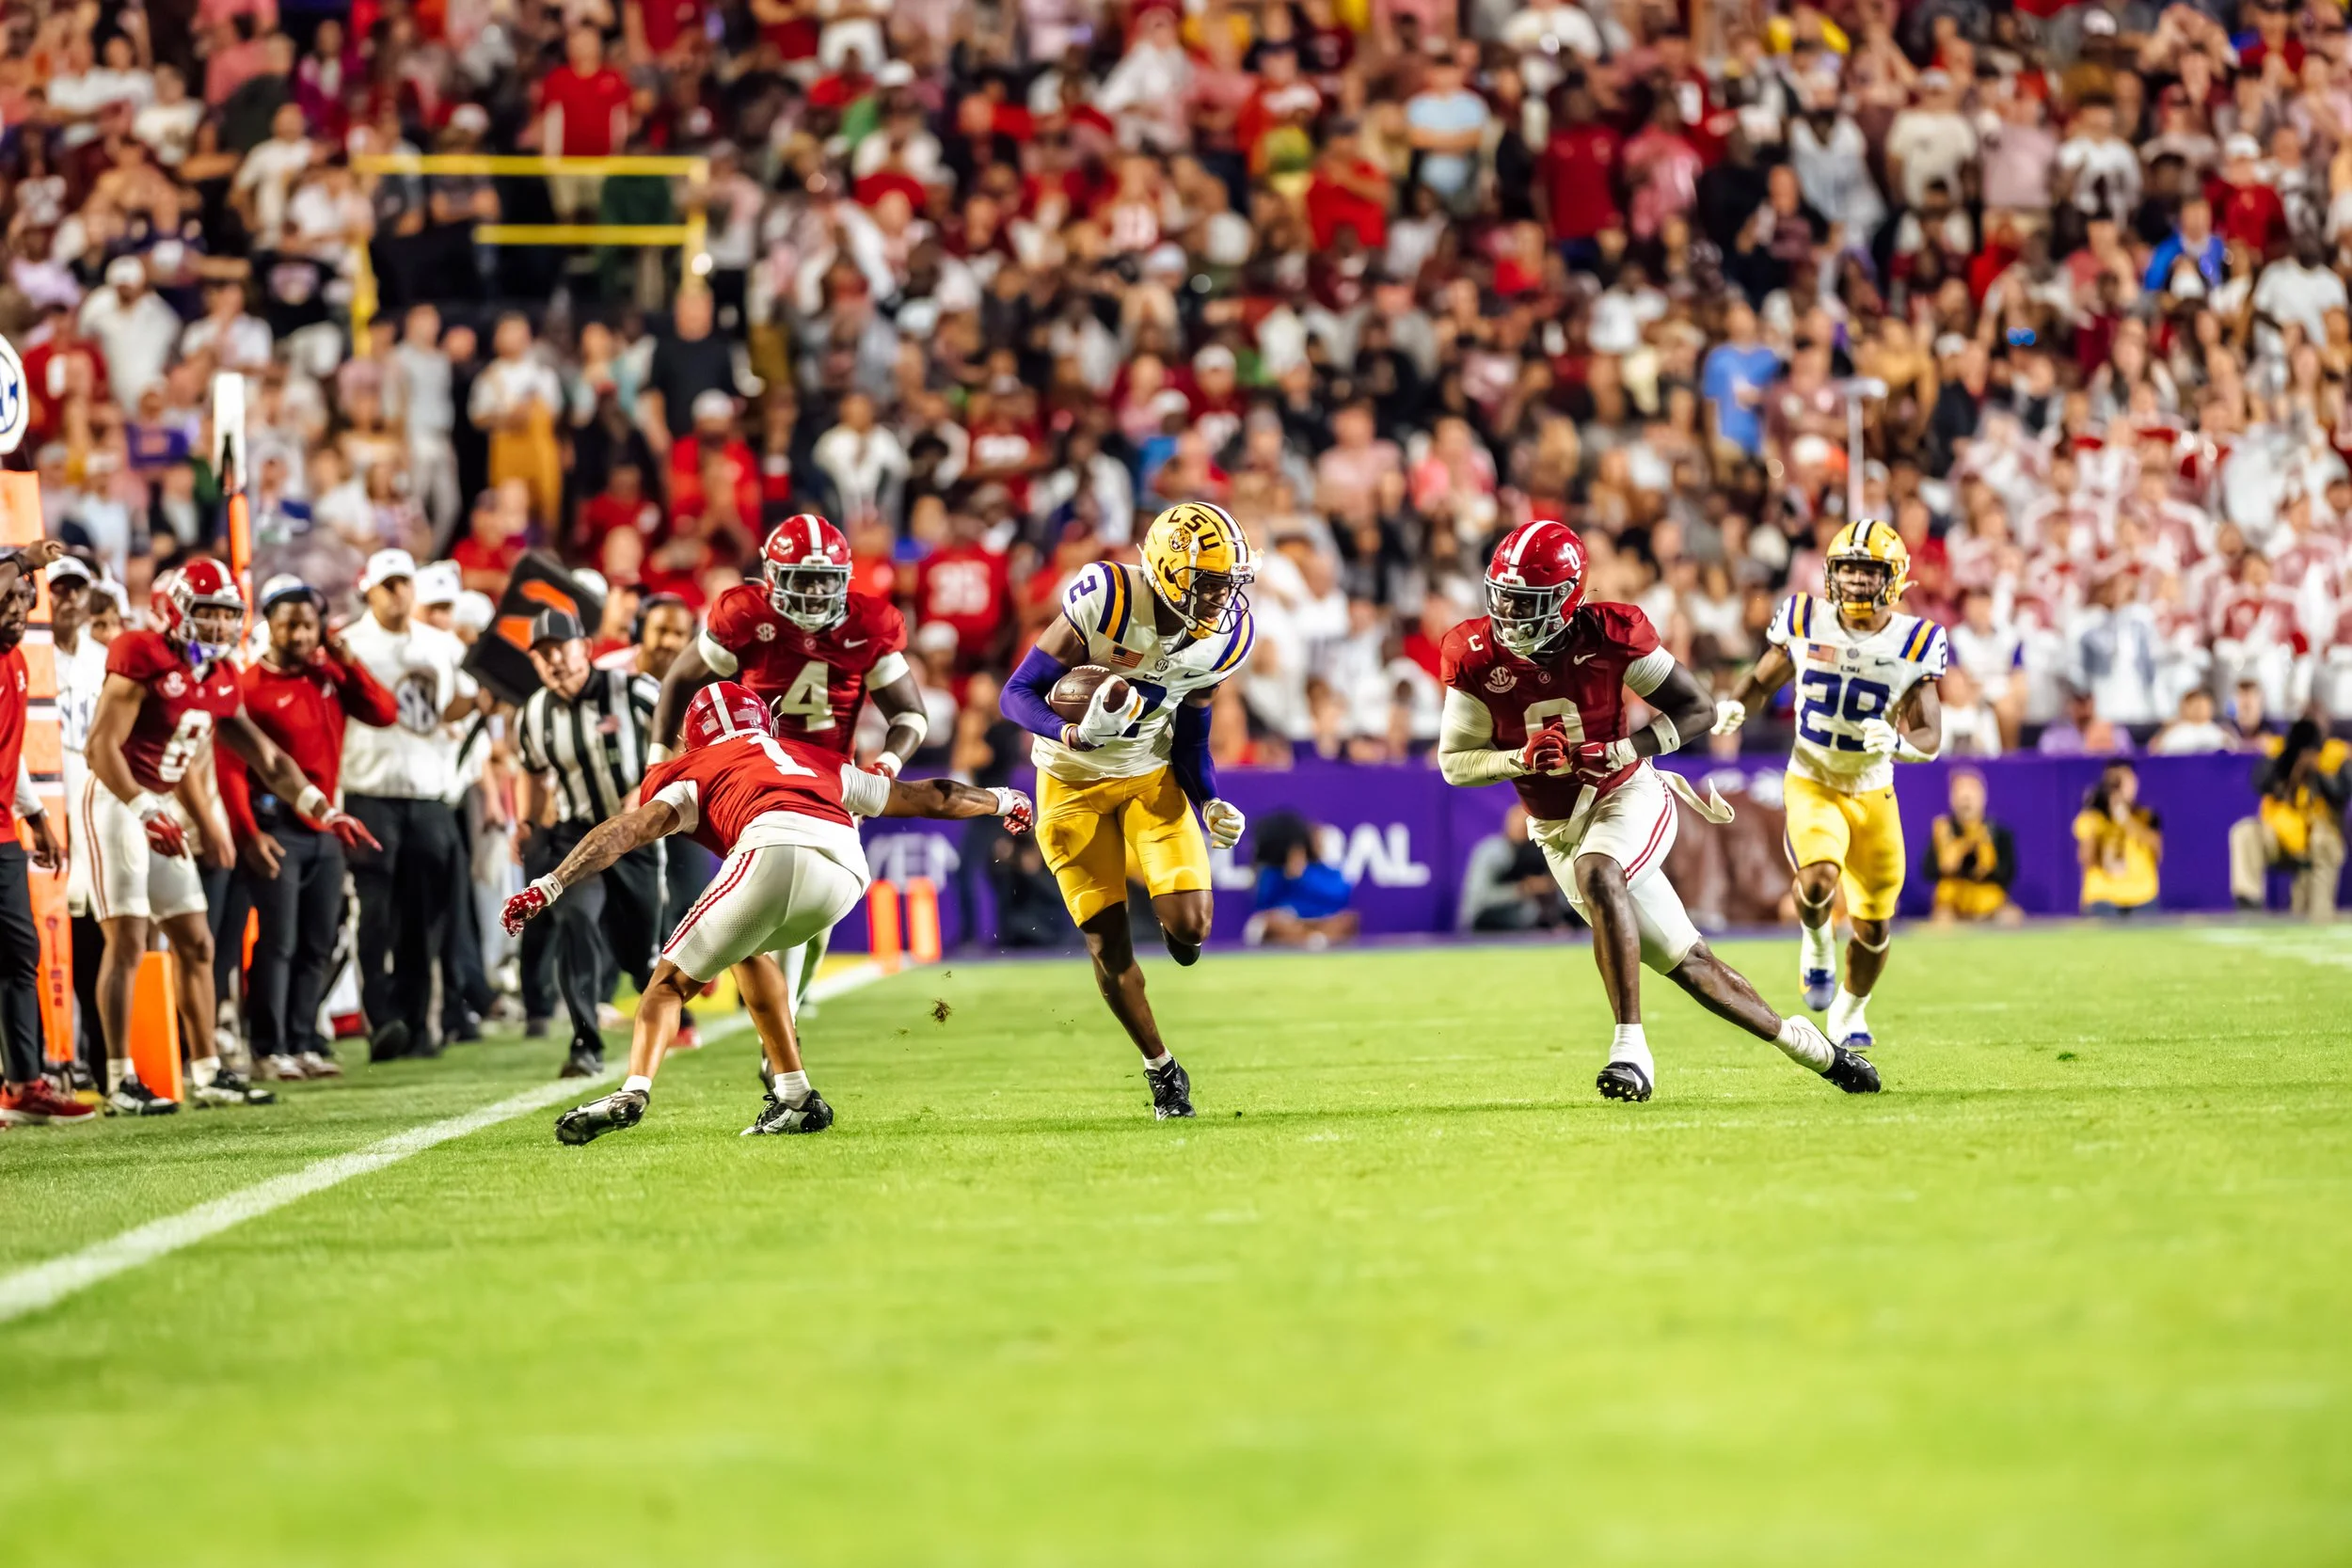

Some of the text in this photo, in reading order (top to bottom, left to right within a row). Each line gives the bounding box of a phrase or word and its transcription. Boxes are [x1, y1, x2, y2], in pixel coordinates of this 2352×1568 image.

[1168, 509, 1221, 552] LSU
[1069, 575, 1098, 604] 2
[755, 623, 776, 641] SEC
[1468, 634, 1484, 652] C
[780, 660, 836, 732] 4
[1489, 666, 1511, 686] SEC
[1800, 669, 1890, 752] 29
[158, 708, 213, 783] 8
[747, 735, 818, 778] 1
[1523, 697, 1586, 777] 0
